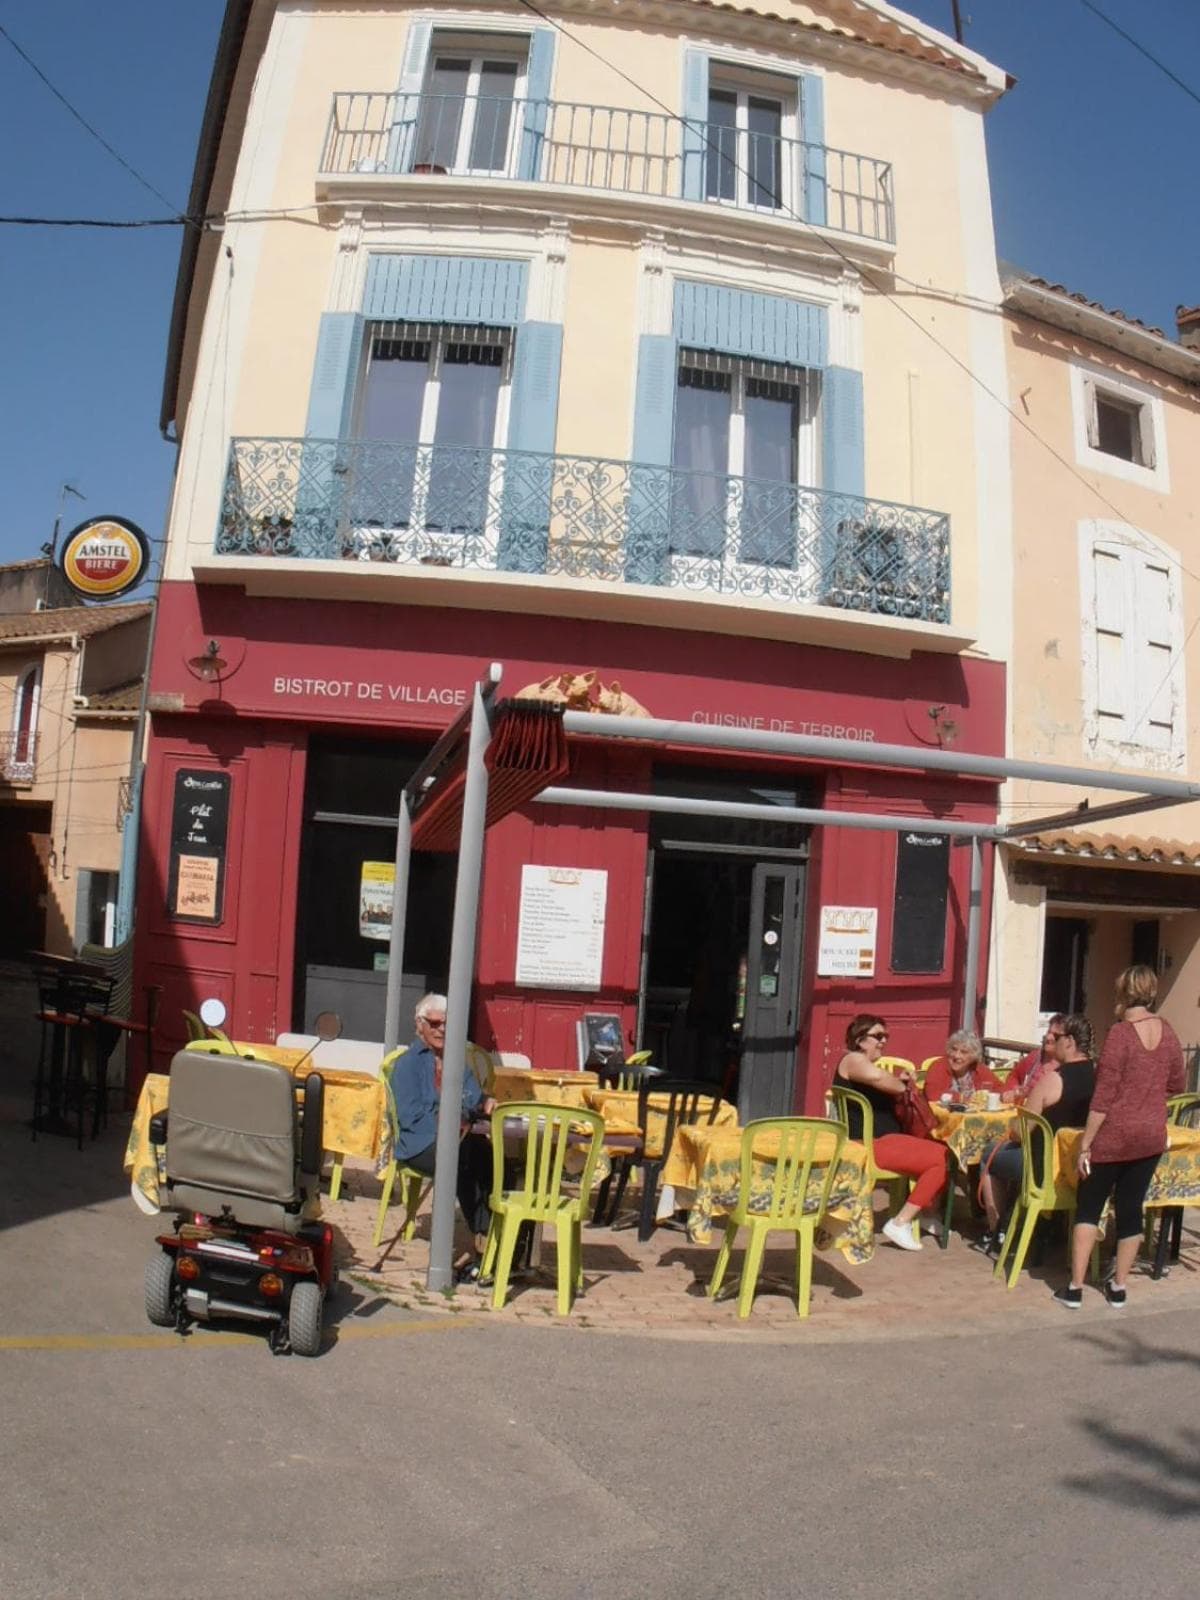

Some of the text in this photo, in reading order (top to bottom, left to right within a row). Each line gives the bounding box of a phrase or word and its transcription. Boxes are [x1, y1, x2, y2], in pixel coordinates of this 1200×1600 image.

[79, 544, 127, 557] AMSTEL
[85, 559, 118, 570] BIERE
[274, 677, 467, 706] BISTROT DE VILLAGE
[691, 710, 876, 743] CUISINE DE TERROIR
